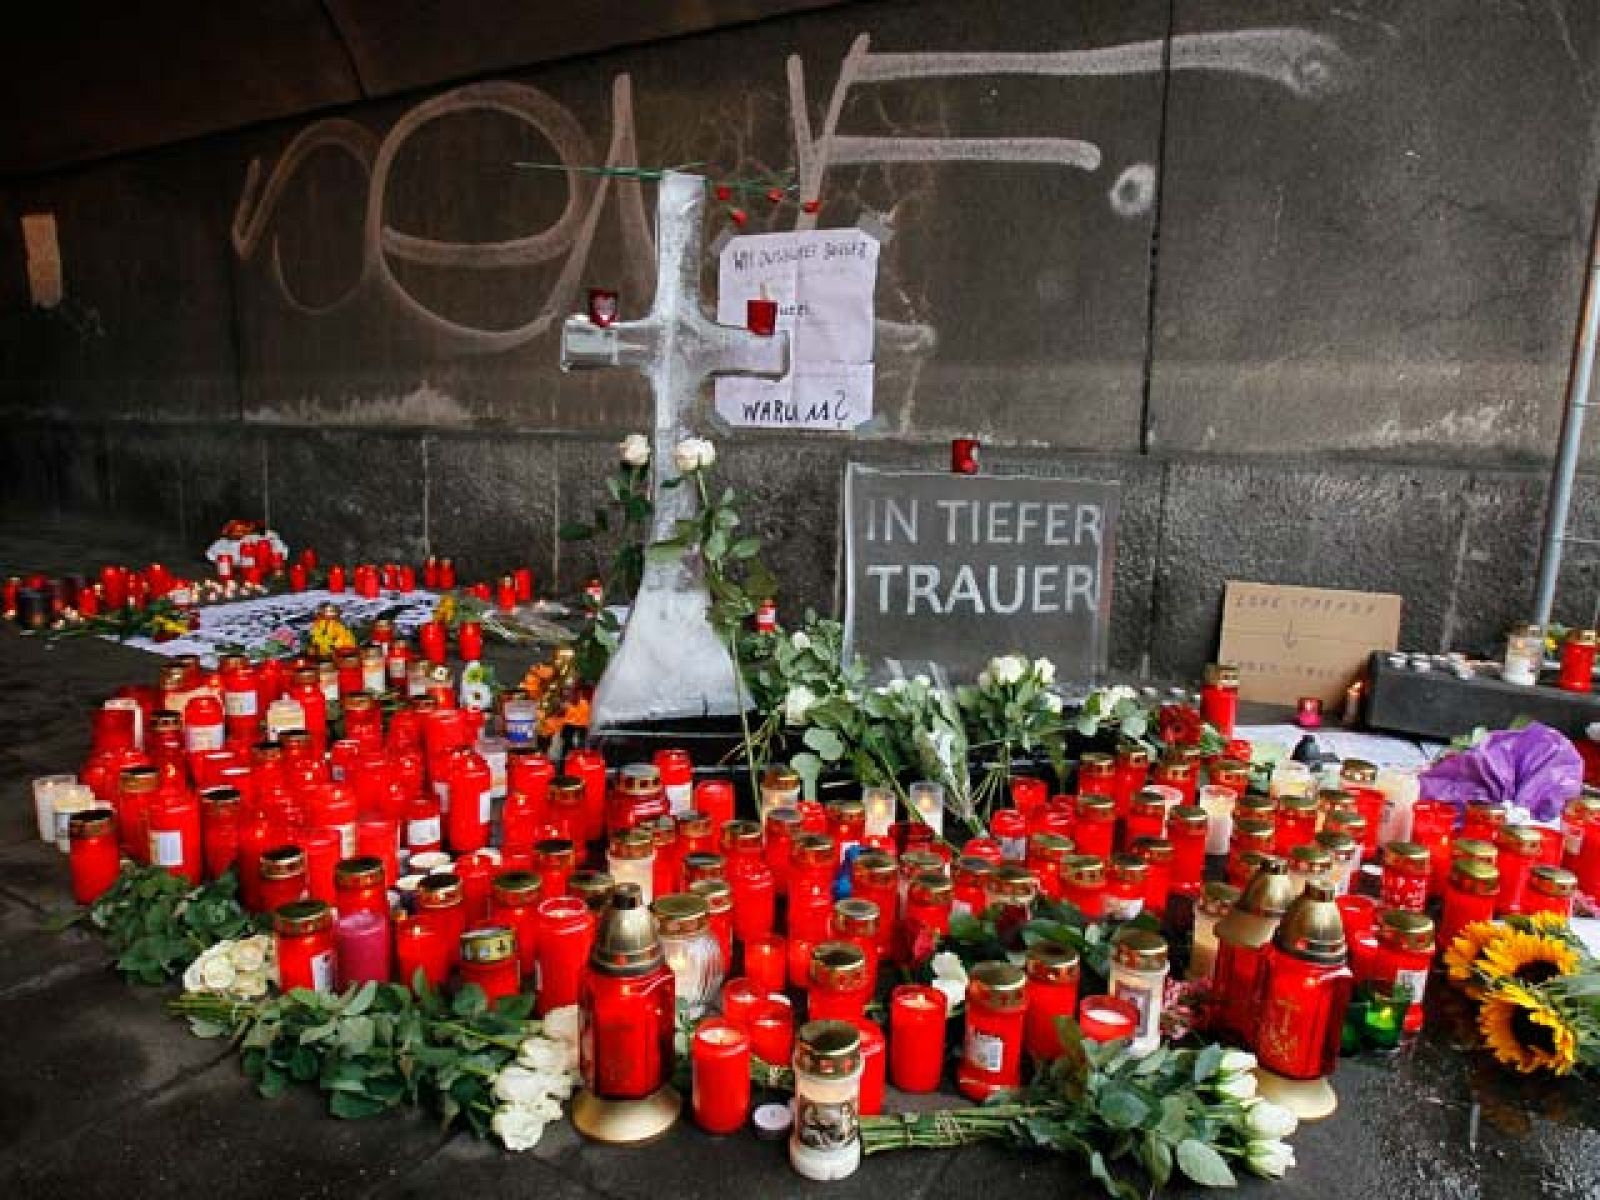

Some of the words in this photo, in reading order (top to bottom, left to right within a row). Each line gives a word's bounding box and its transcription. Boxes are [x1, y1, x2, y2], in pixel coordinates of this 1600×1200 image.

[866, 499, 918, 542] IN
[936, 499, 1102, 546] TIEFER
[865, 564, 1099, 615] TRAUER
